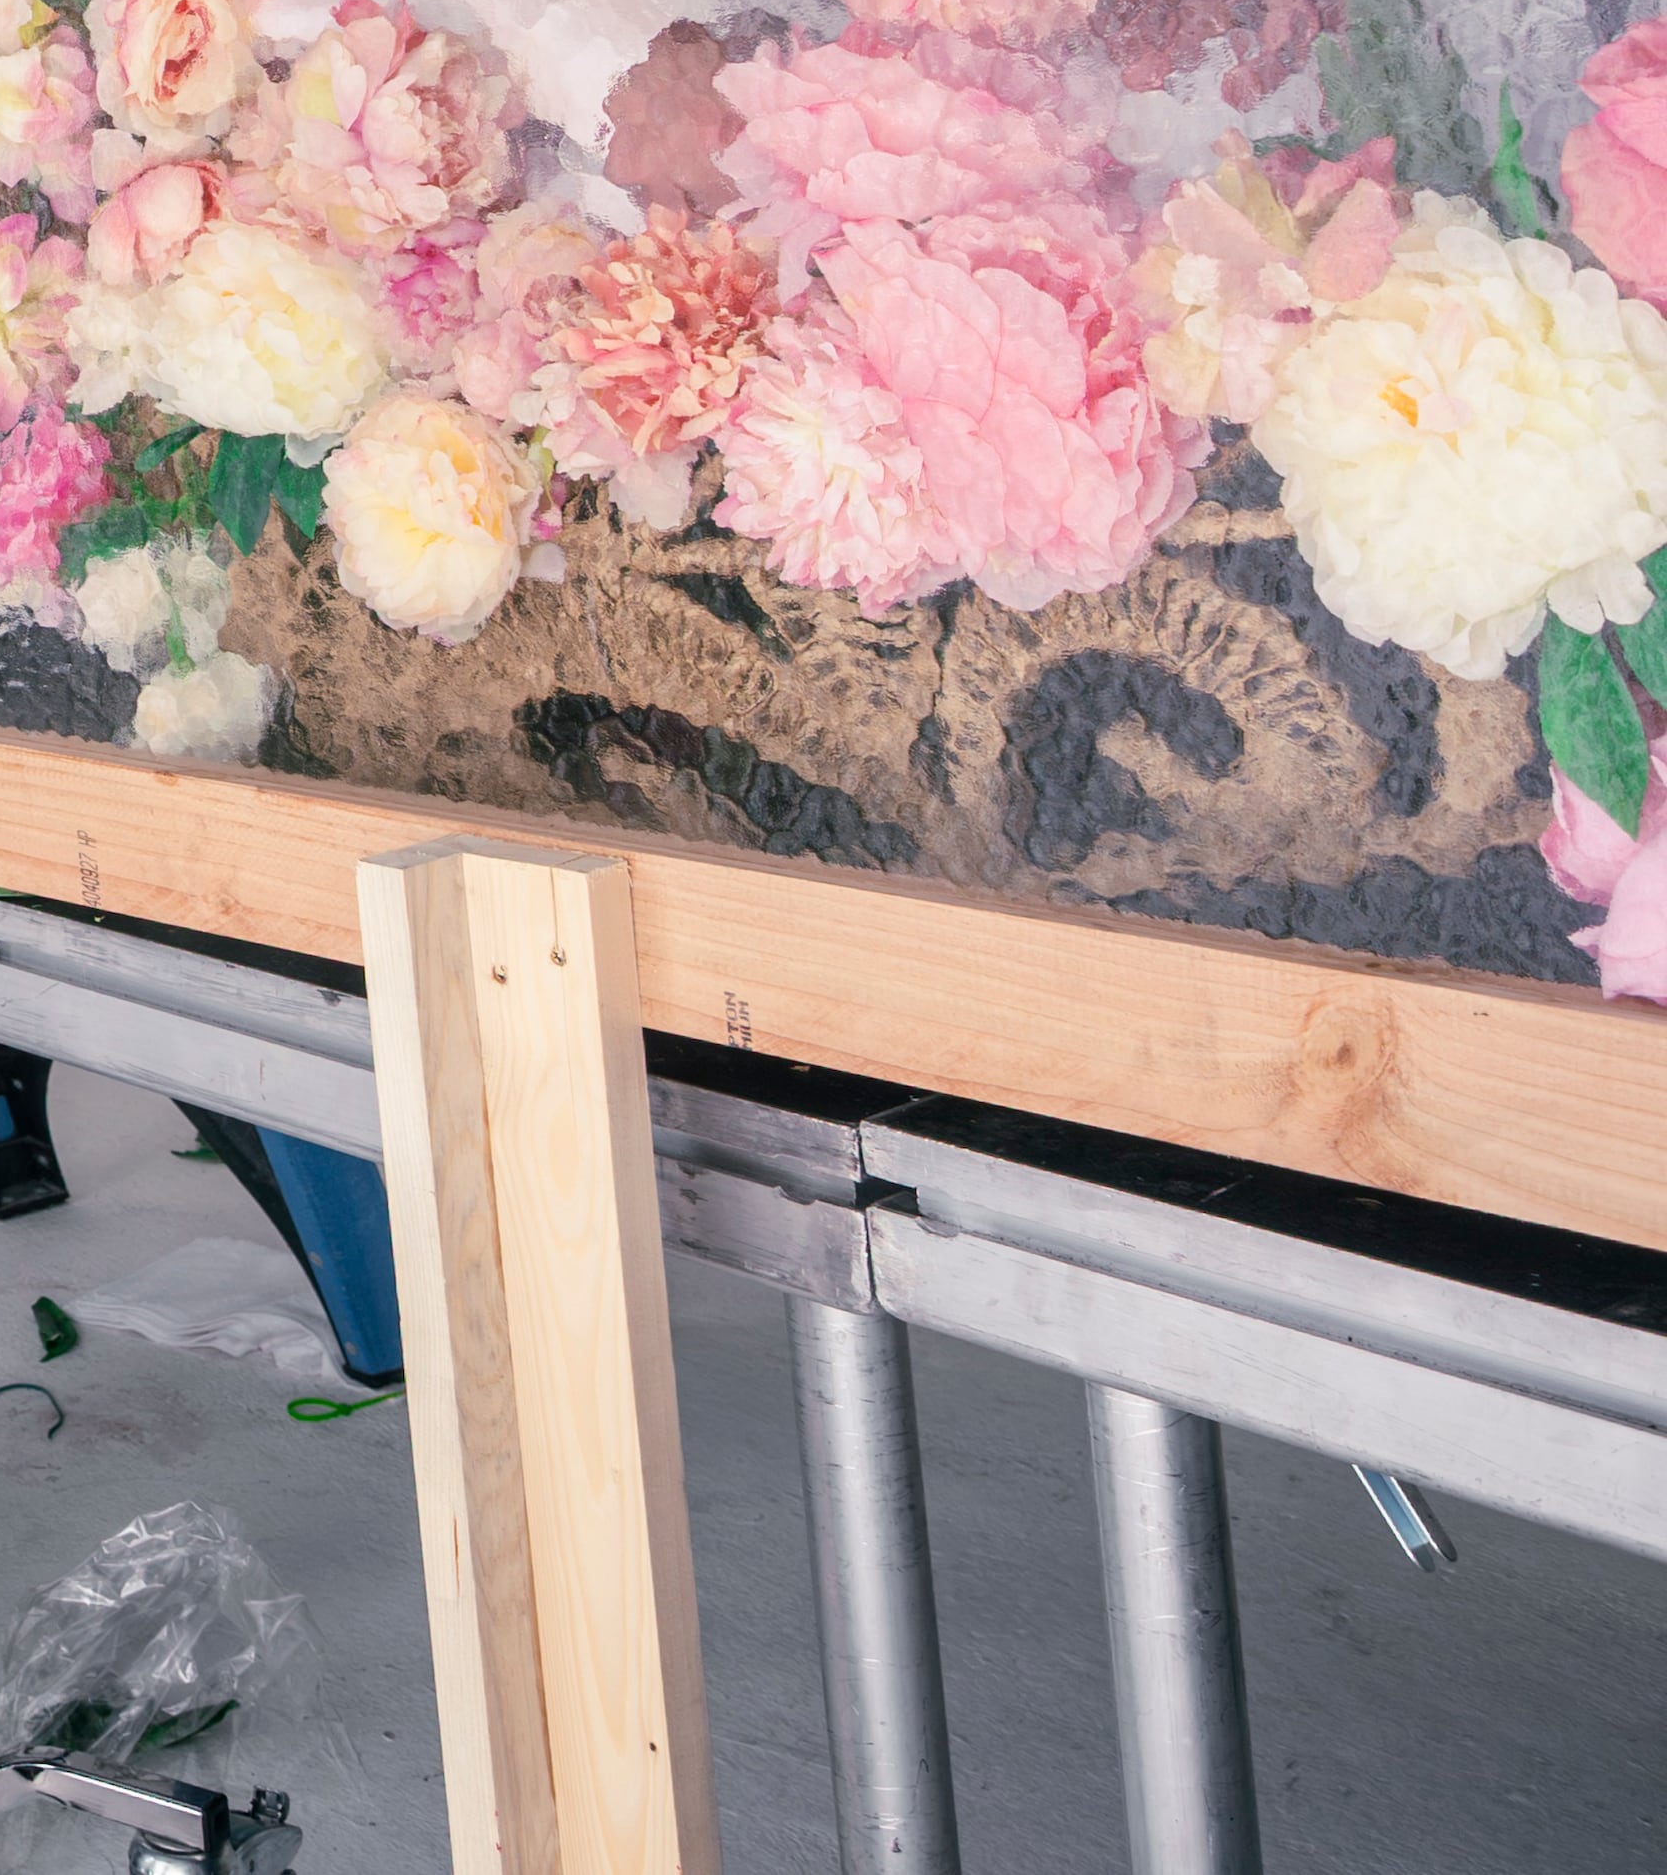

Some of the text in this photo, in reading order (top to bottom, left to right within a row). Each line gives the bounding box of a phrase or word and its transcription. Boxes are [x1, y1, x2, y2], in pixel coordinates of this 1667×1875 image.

[77, 830, 97, 848] HP
[723, 990, 739, 1047] PTON
[738, 1000, 753, 1049] MIUM
